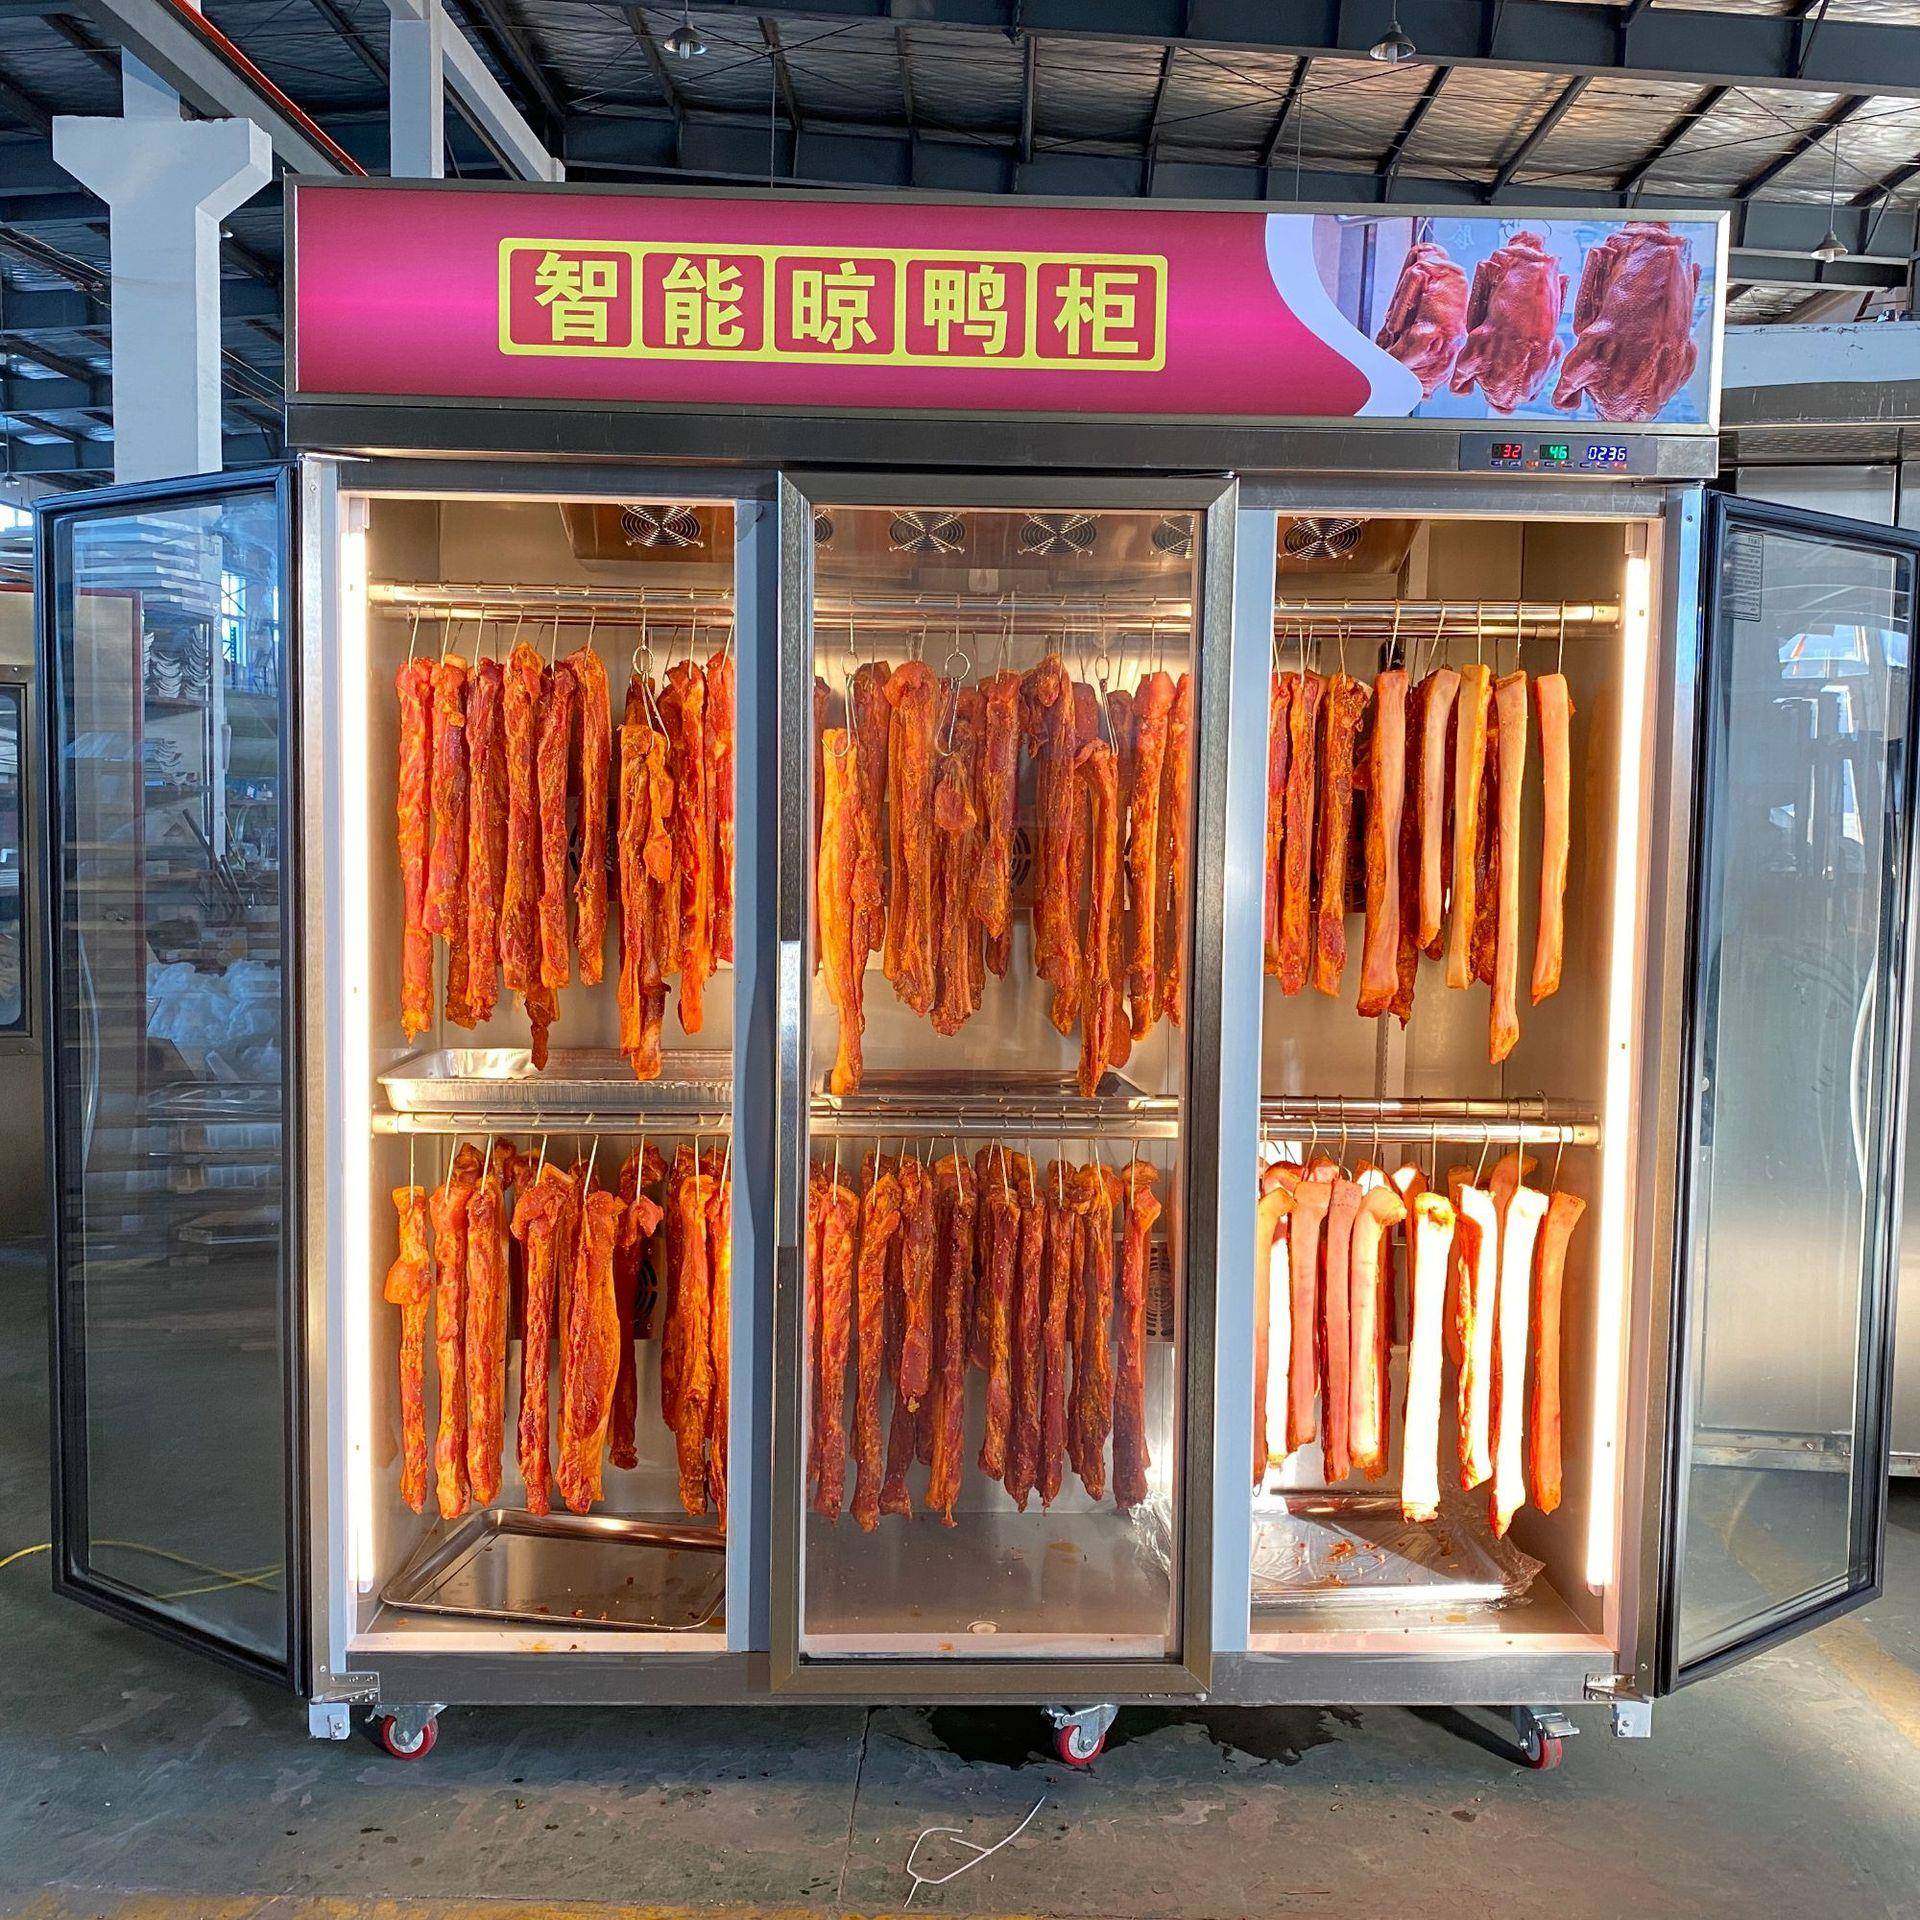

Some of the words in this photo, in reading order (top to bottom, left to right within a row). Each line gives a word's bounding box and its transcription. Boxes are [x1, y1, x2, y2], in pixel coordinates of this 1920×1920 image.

[535, 251, 1139, 355] 智能晾鸭柜
[1503, 444, 1521, 458] 32
[1549, 445, 1568, 459] 46
[1587, 446, 1626, 461] 0236
